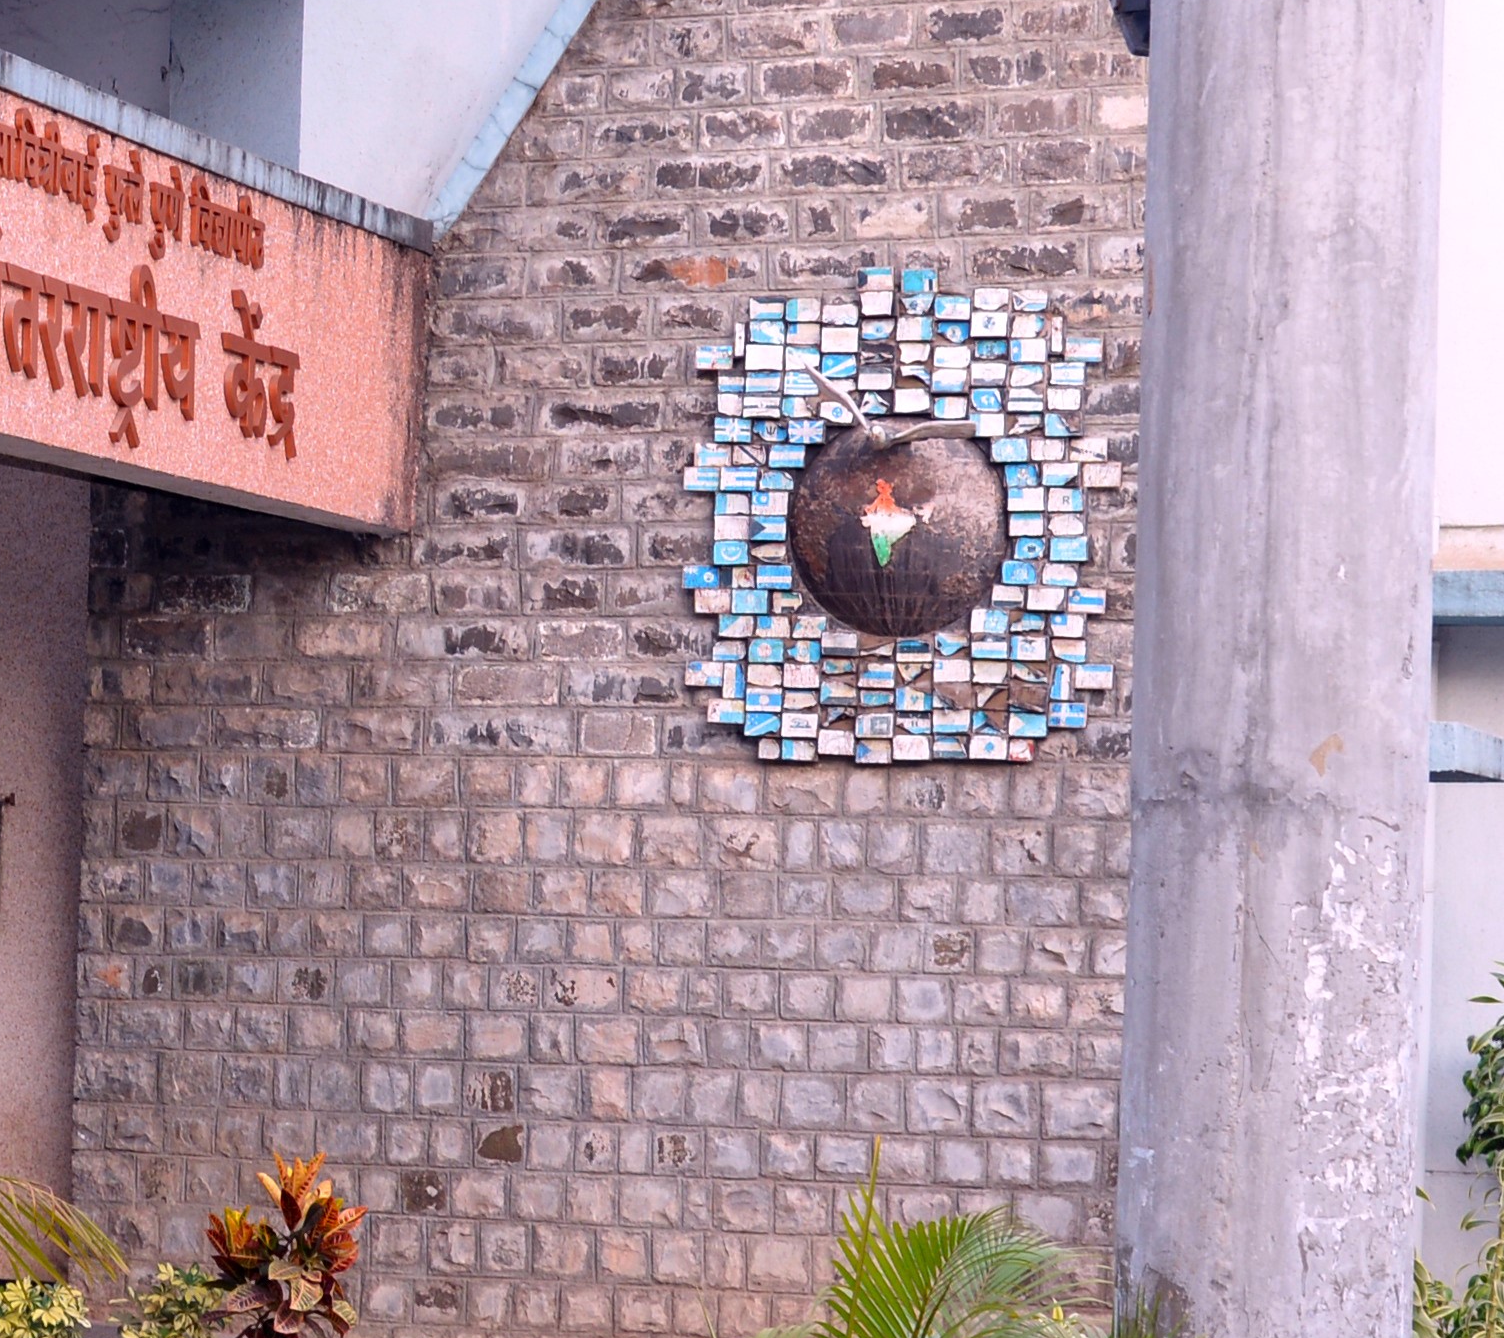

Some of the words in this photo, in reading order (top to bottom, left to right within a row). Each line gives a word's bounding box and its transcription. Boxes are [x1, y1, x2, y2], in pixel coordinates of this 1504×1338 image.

[102, 149, 146, 244] फुले
[148, 165, 186, 262] पुणे
[189, 174, 267, 271] विद्यापीठ
[220, 289, 301, 461] केंद्र
